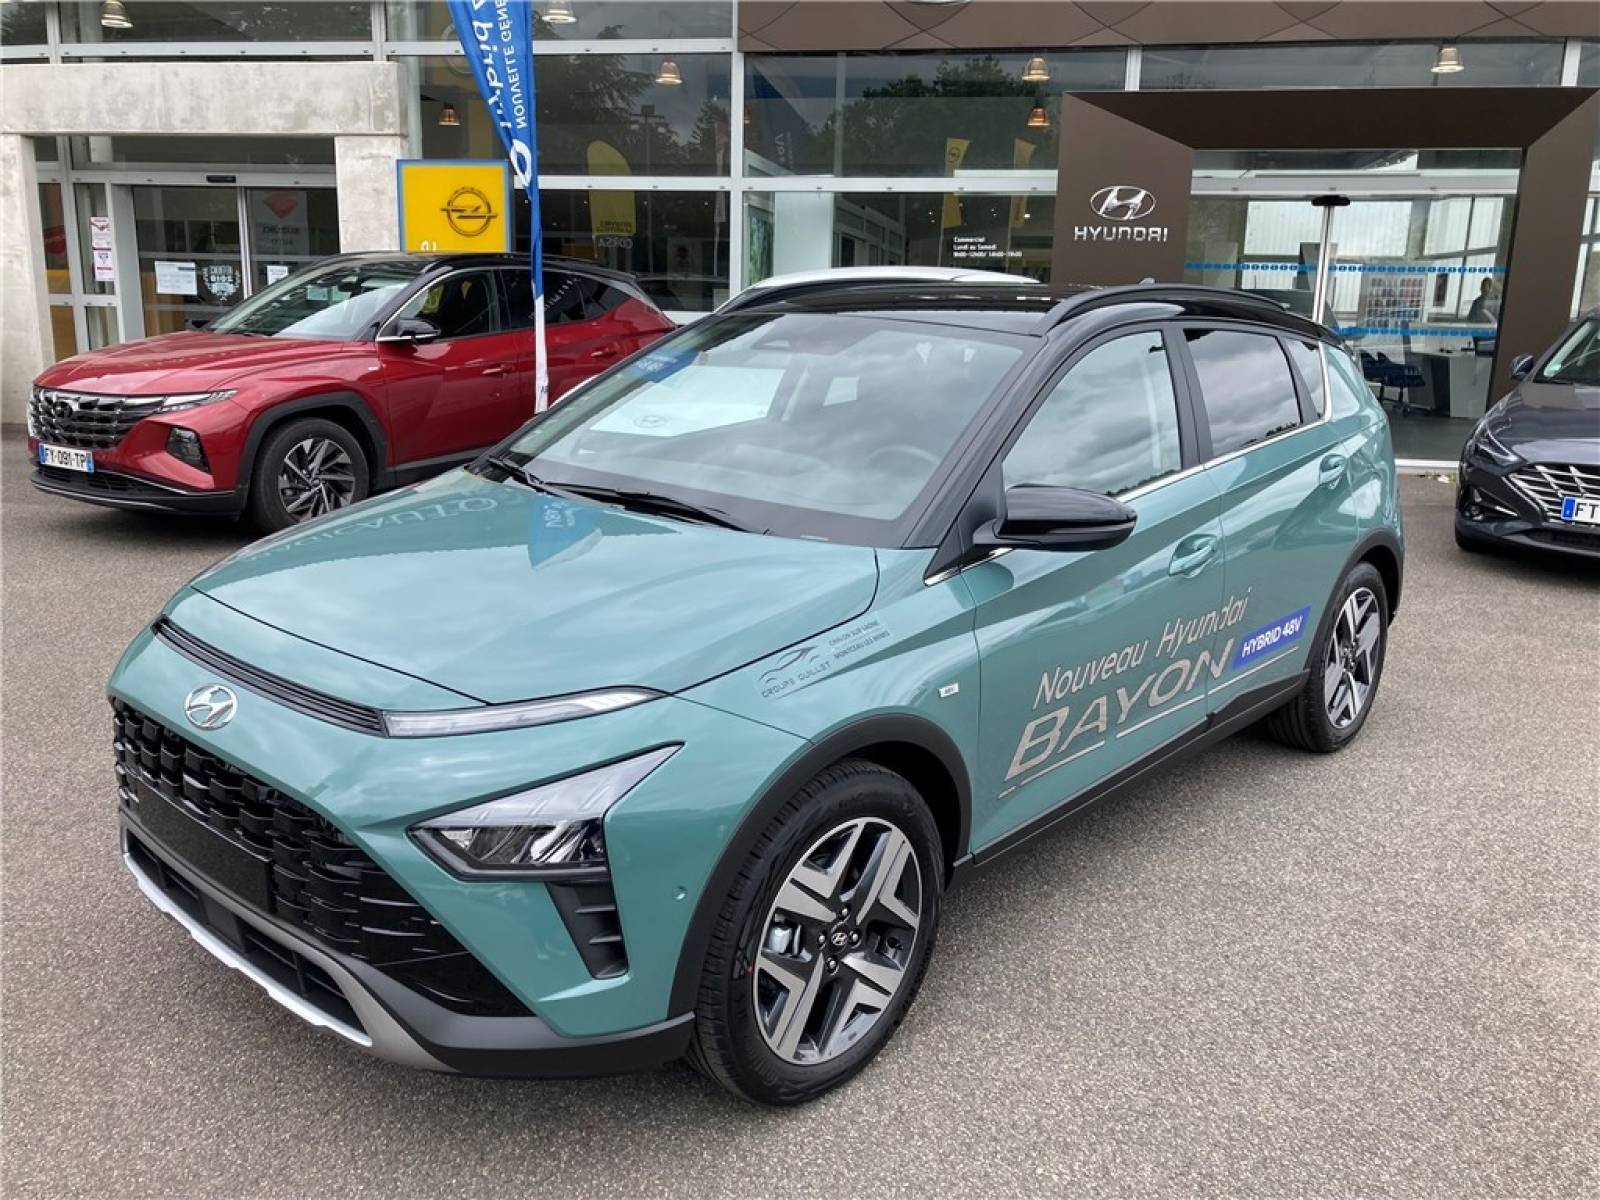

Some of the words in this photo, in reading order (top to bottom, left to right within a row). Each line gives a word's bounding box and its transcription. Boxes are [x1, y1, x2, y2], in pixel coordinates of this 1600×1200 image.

[1074, 225, 1168, 242] HYUNDAI
[1033, 639, 1149, 710] Nouveau
[1155, 586, 1253, 658] Hyundai
[1242, 627, 1281, 658] HYBRID
[1281, 615, 1304, 638] 48V
[760, 677, 796, 699] GROUPE
[798, 660, 832, 681] GUILLET
[1004, 638, 1235, 782] BAYON
